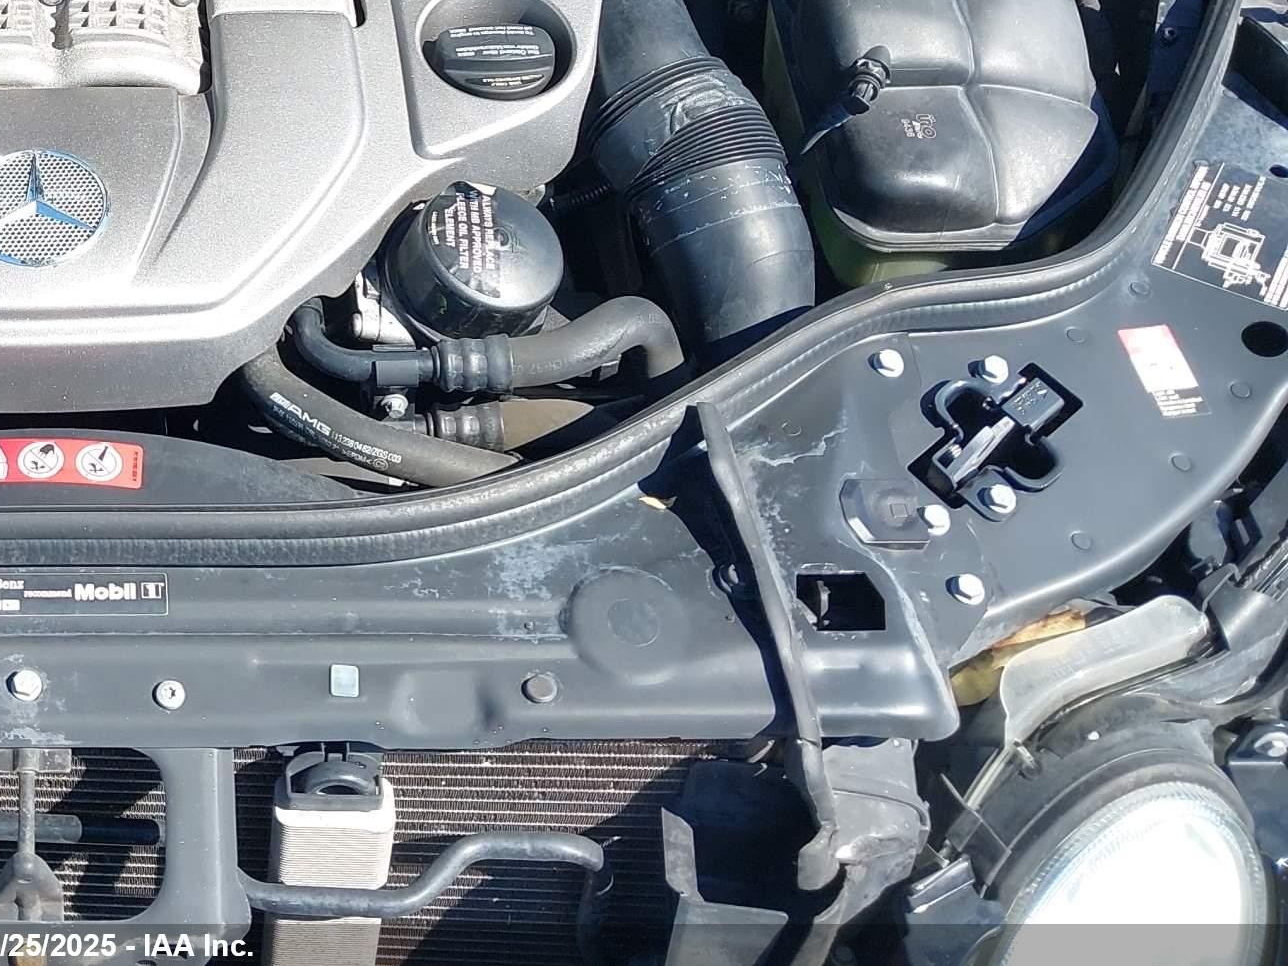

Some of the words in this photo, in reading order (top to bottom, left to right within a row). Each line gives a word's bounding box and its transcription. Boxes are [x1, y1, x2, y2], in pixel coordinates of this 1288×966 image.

[455, 192, 468, 222] FLEECE
[468, 189, 480, 211] WITH
[481, 194, 495, 228] ALWAYS
[443, 208, 456, 248] ELEMENT
[457, 222, 468, 237] OIL
[470, 211, 481, 224] MB
[458, 238, 470, 270] FILTER
[471, 224, 483, 274] APPROVED
[484, 228, 496, 270] REPLACE
[74, 582, 137, 601] Mobil
